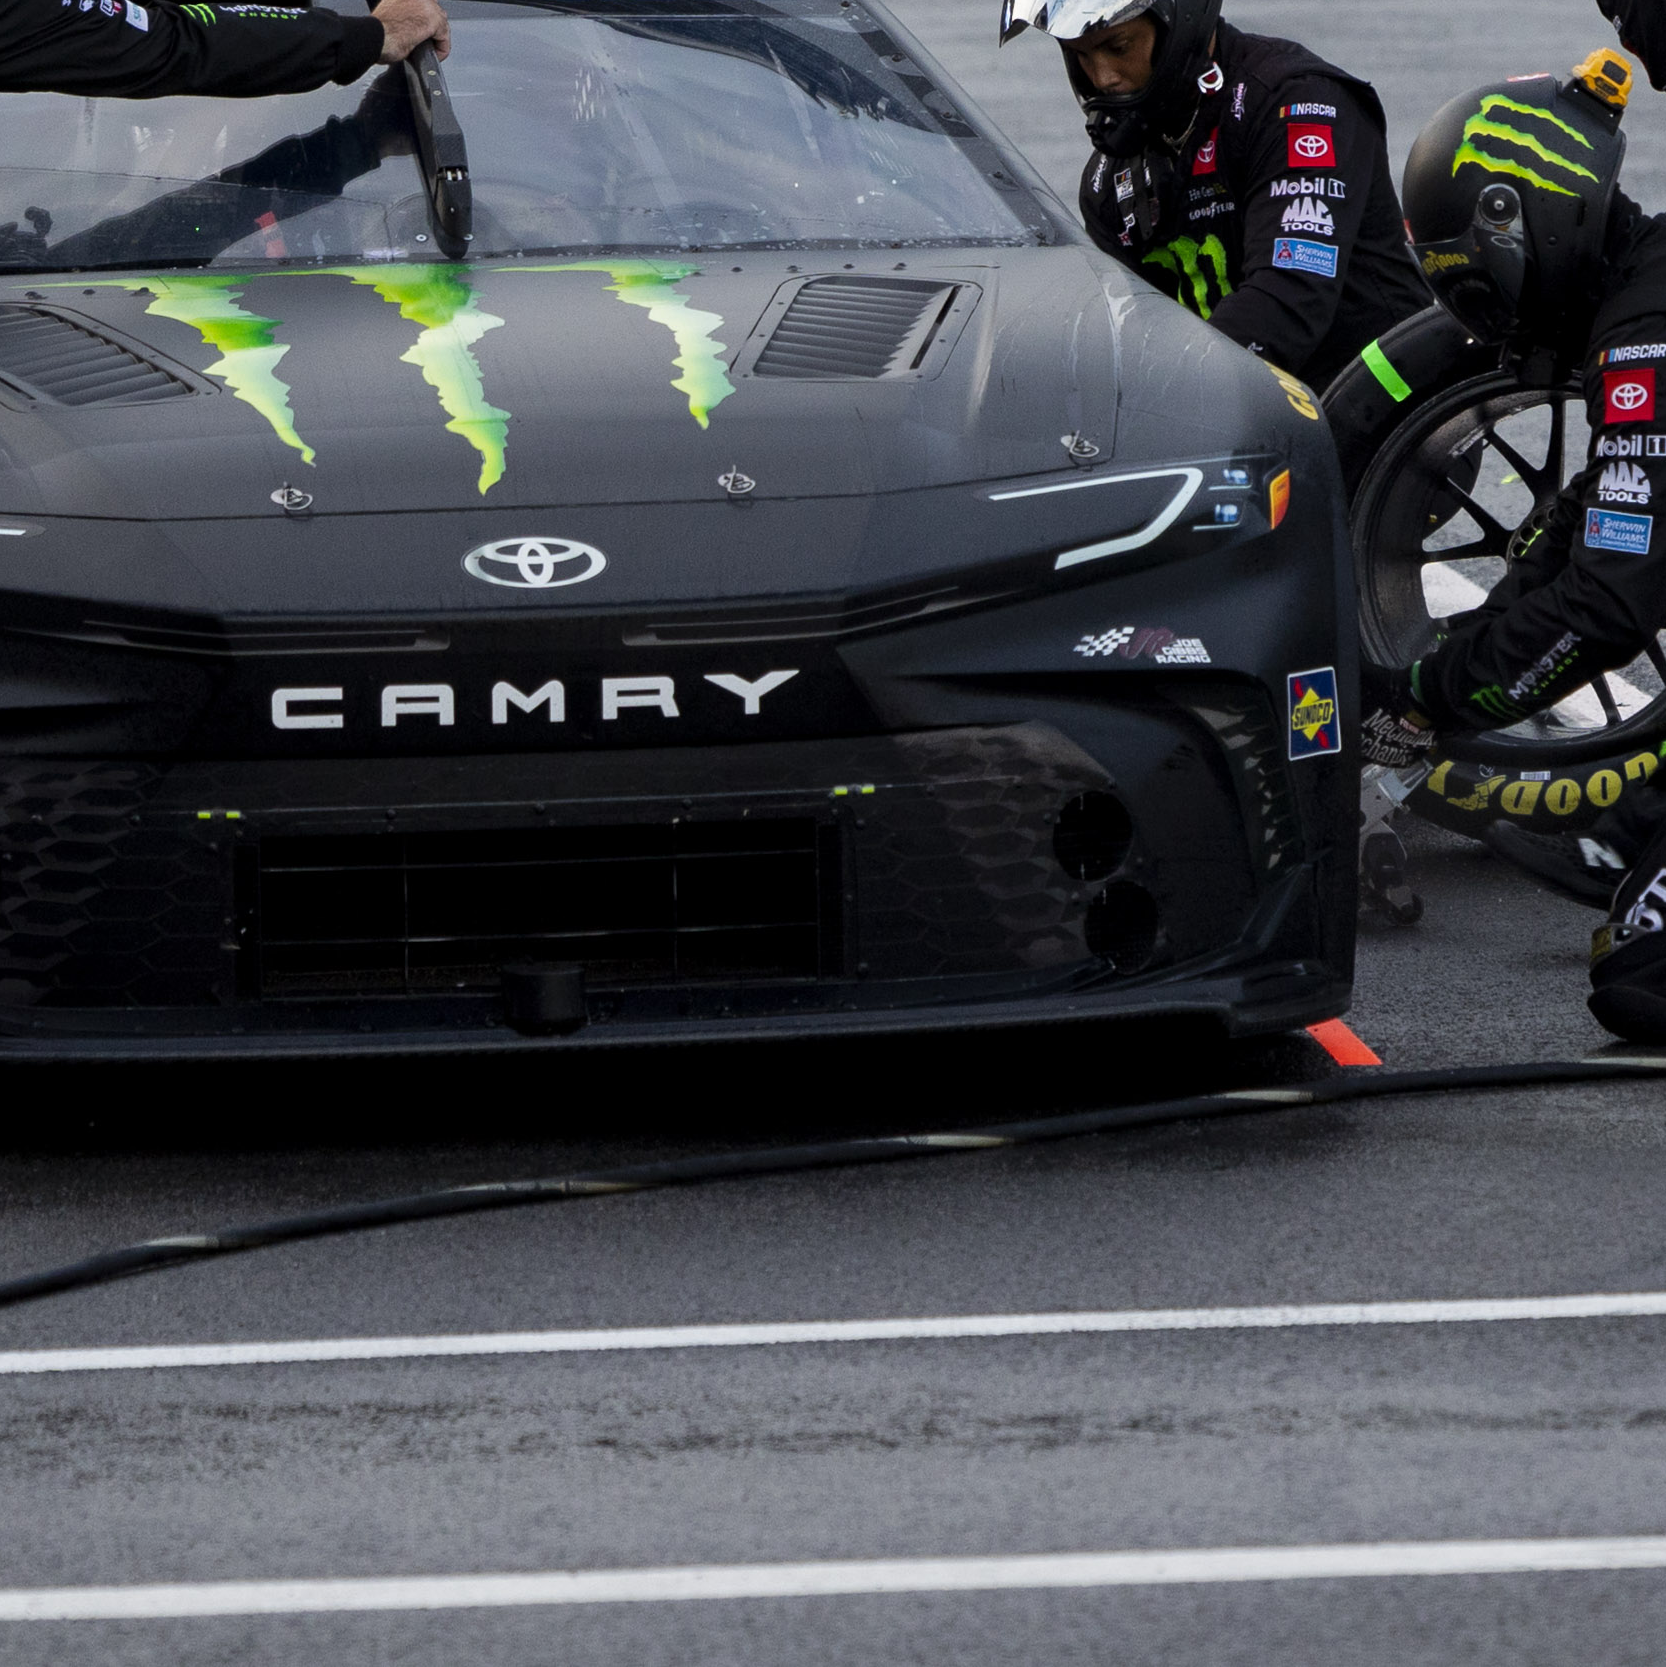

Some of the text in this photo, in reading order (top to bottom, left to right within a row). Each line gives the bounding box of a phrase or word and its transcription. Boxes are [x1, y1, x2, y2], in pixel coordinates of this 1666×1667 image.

[1297, 102, 1337, 118] NASCAR
[1270, 177, 1325, 197] Mobil
[1189, 201, 1235, 220] GOODYEAR
[1281, 197, 1332, 225] MAC
[1281, 222, 1334, 236] TOOLS
[1294, 244, 1333, 260] SHERWIN
[1599, 461, 1651, 493] MAC
[1598, 491, 1652, 505] TOOLS
[1602, 517, 1647, 534] SHERWIN
[1162, 646, 1207, 655] GIBBS
[1172, 638, 1202, 647] JOE
[1155, 654, 1211, 664] RACING
[1508, 631, 1581, 701] MONSTER
[271, 670, 800, 730] CAMRY
[1292, 700, 1333, 728] SUNOCO
